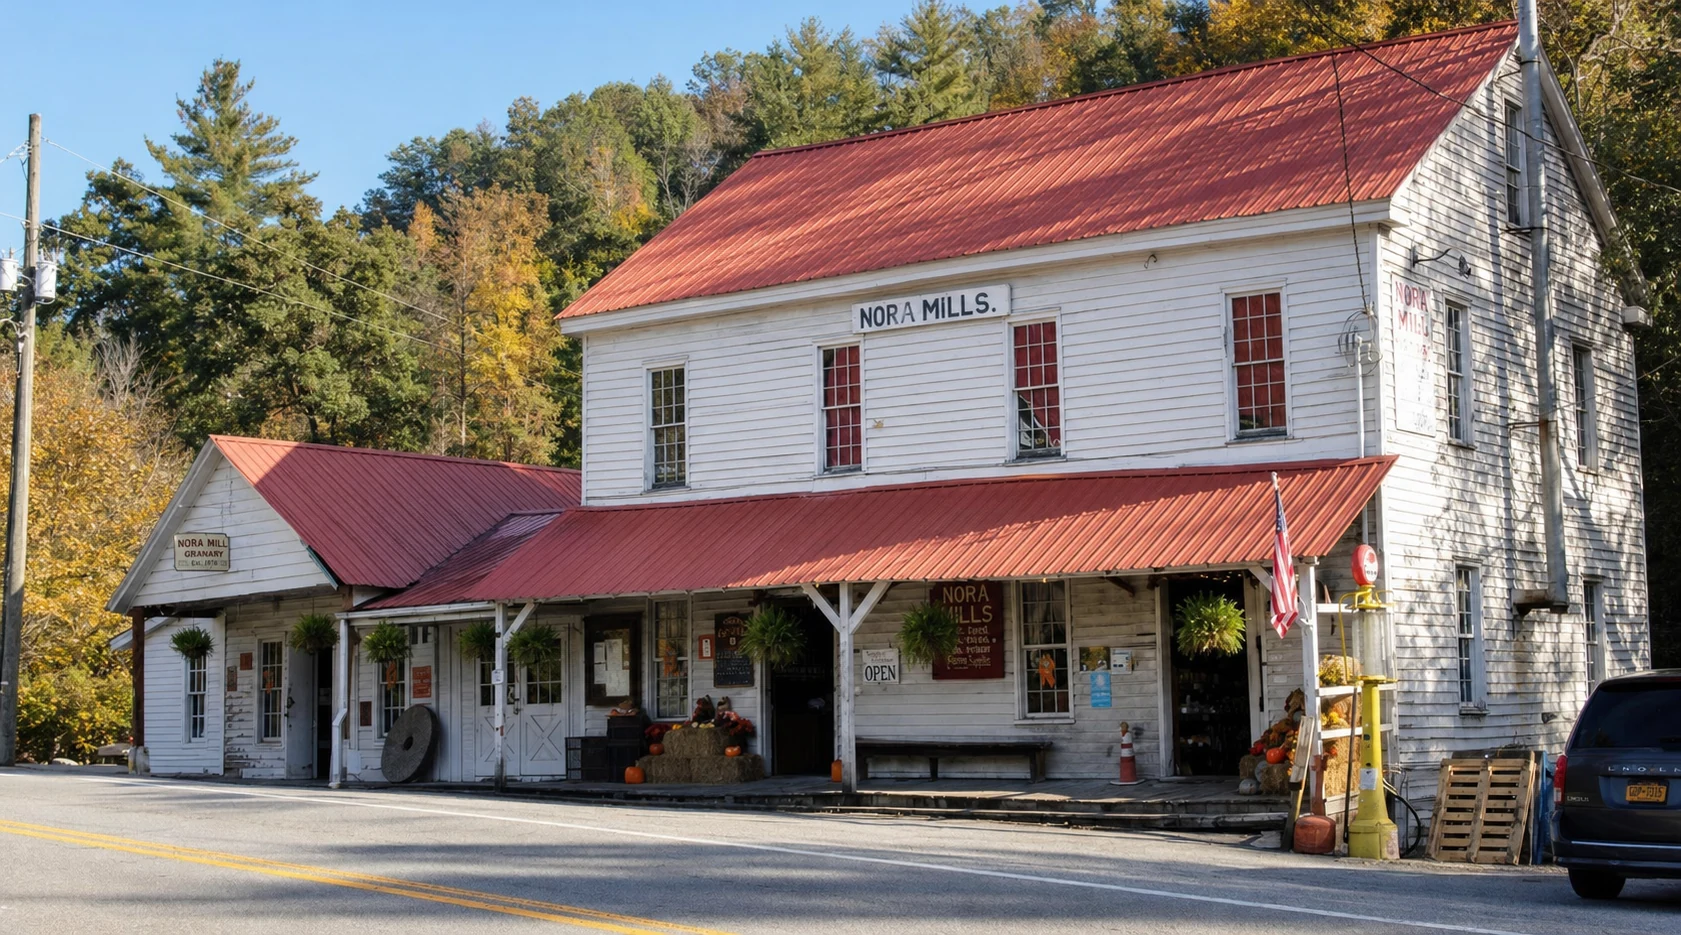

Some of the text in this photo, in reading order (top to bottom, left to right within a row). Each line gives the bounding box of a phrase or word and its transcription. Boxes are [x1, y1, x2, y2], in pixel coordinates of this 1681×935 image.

[1395, 281, 1428, 313] NORA
[860, 301, 915, 329] NORA
[178, 539, 227, 547] NORA MILL
[943, 584, 990, 603] NORA
[864, 665, 896, 682] OPEN
